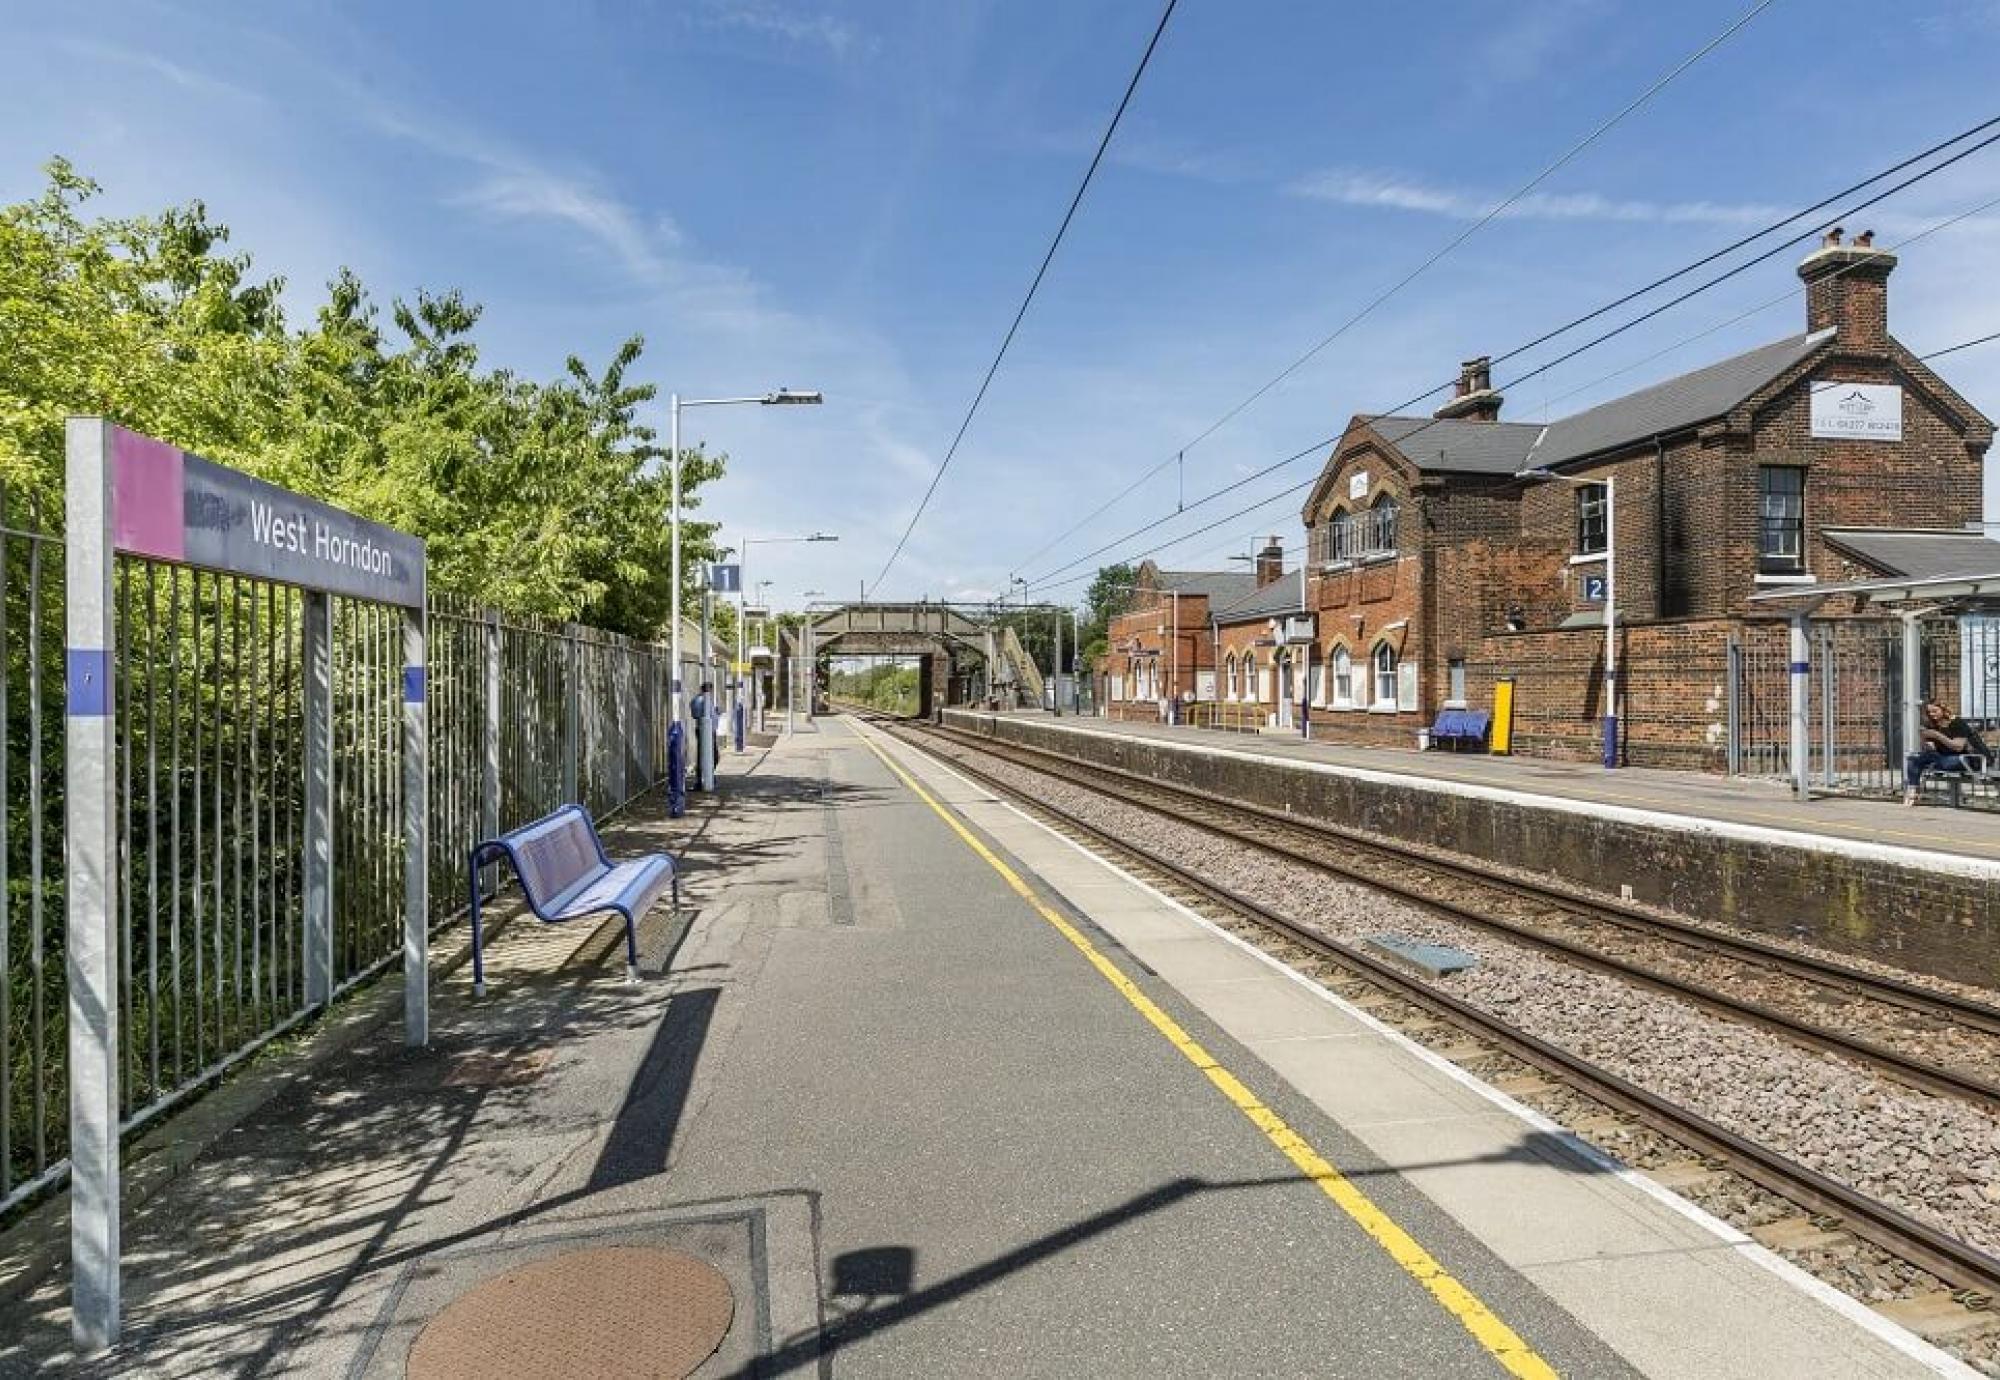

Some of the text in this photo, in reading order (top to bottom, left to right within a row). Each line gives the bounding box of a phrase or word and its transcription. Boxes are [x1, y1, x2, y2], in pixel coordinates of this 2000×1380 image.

[251, 499, 392, 576] West Horndon
[721, 567, 730, 590] 1
[1590, 579, 1602, 598] 2
